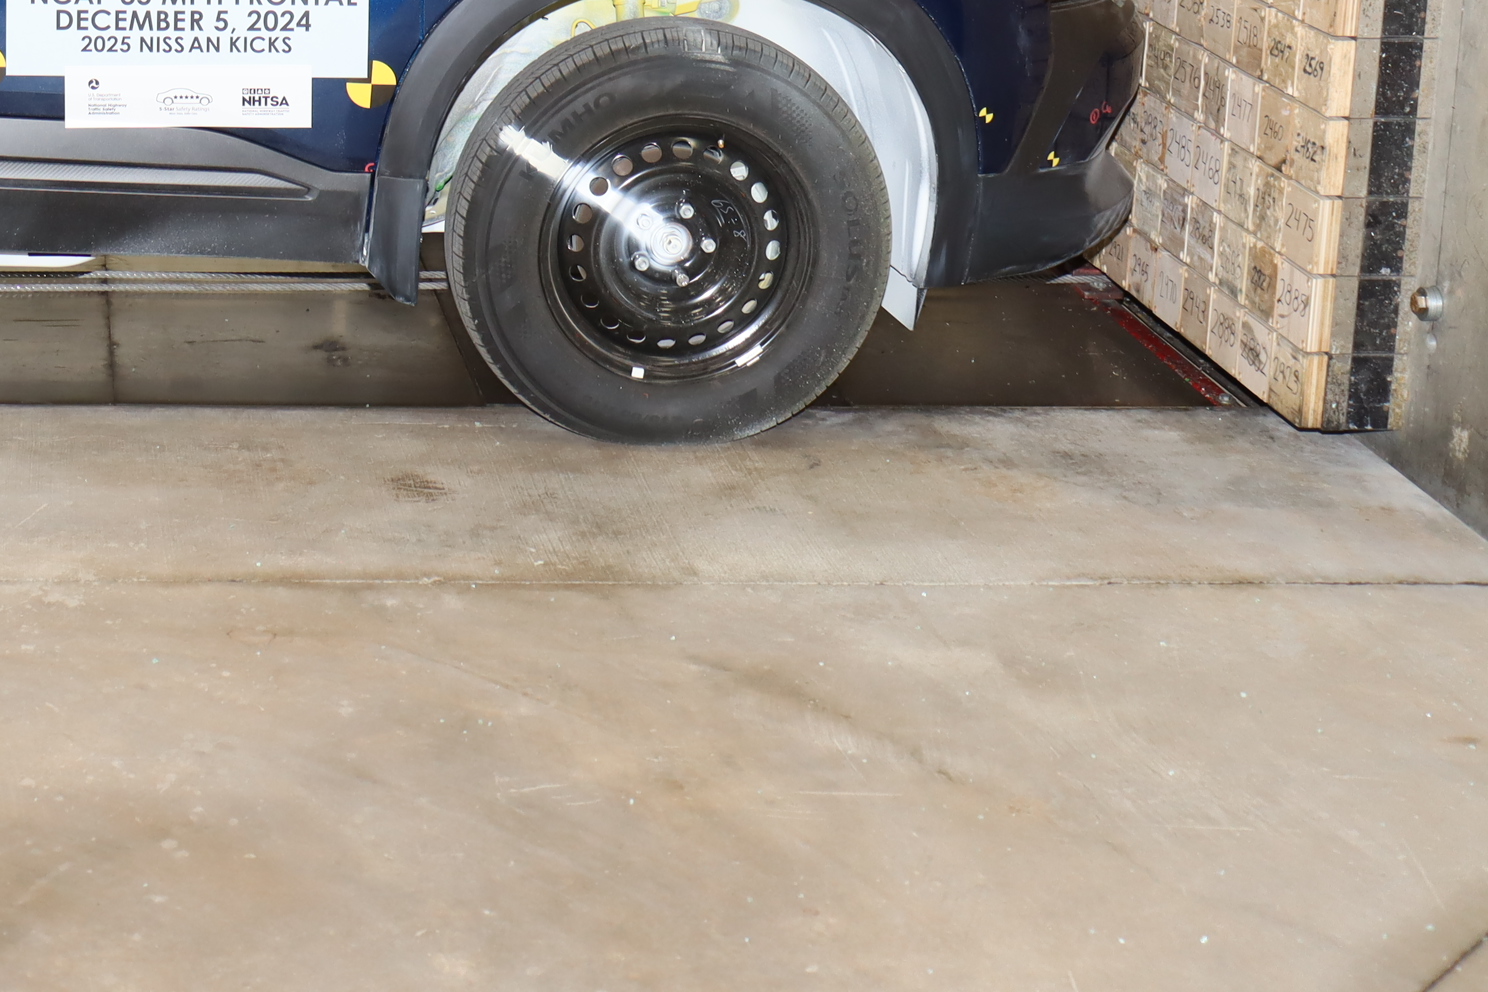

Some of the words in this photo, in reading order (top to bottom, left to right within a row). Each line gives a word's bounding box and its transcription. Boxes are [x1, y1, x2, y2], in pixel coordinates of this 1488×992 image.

[56, 9, 204, 32] DECEMBER
[214, 10, 236, 35] 5,
[246, 10, 312, 32] 2024
[1208, 3, 1231, 34] 2538
[1237, 16, 1258, 52] 2518
[81, 36, 132, 53] 2025
[139, 36, 220, 53] NISSAN
[230, 36, 292, 53] KICKS
[1173, 55, 1200, 92] 2576
[1302, 51, 1324, 82] 2569
[242, 95, 289, 106] NHTSA
[1231, 91, 1252, 126] 2477
[1263, 113, 1283, 145] 2460
[1167, 126, 1192, 168] 2485
[1194, 143, 1220, 187] 2468
[1285, 200, 1315, 244] 2475
